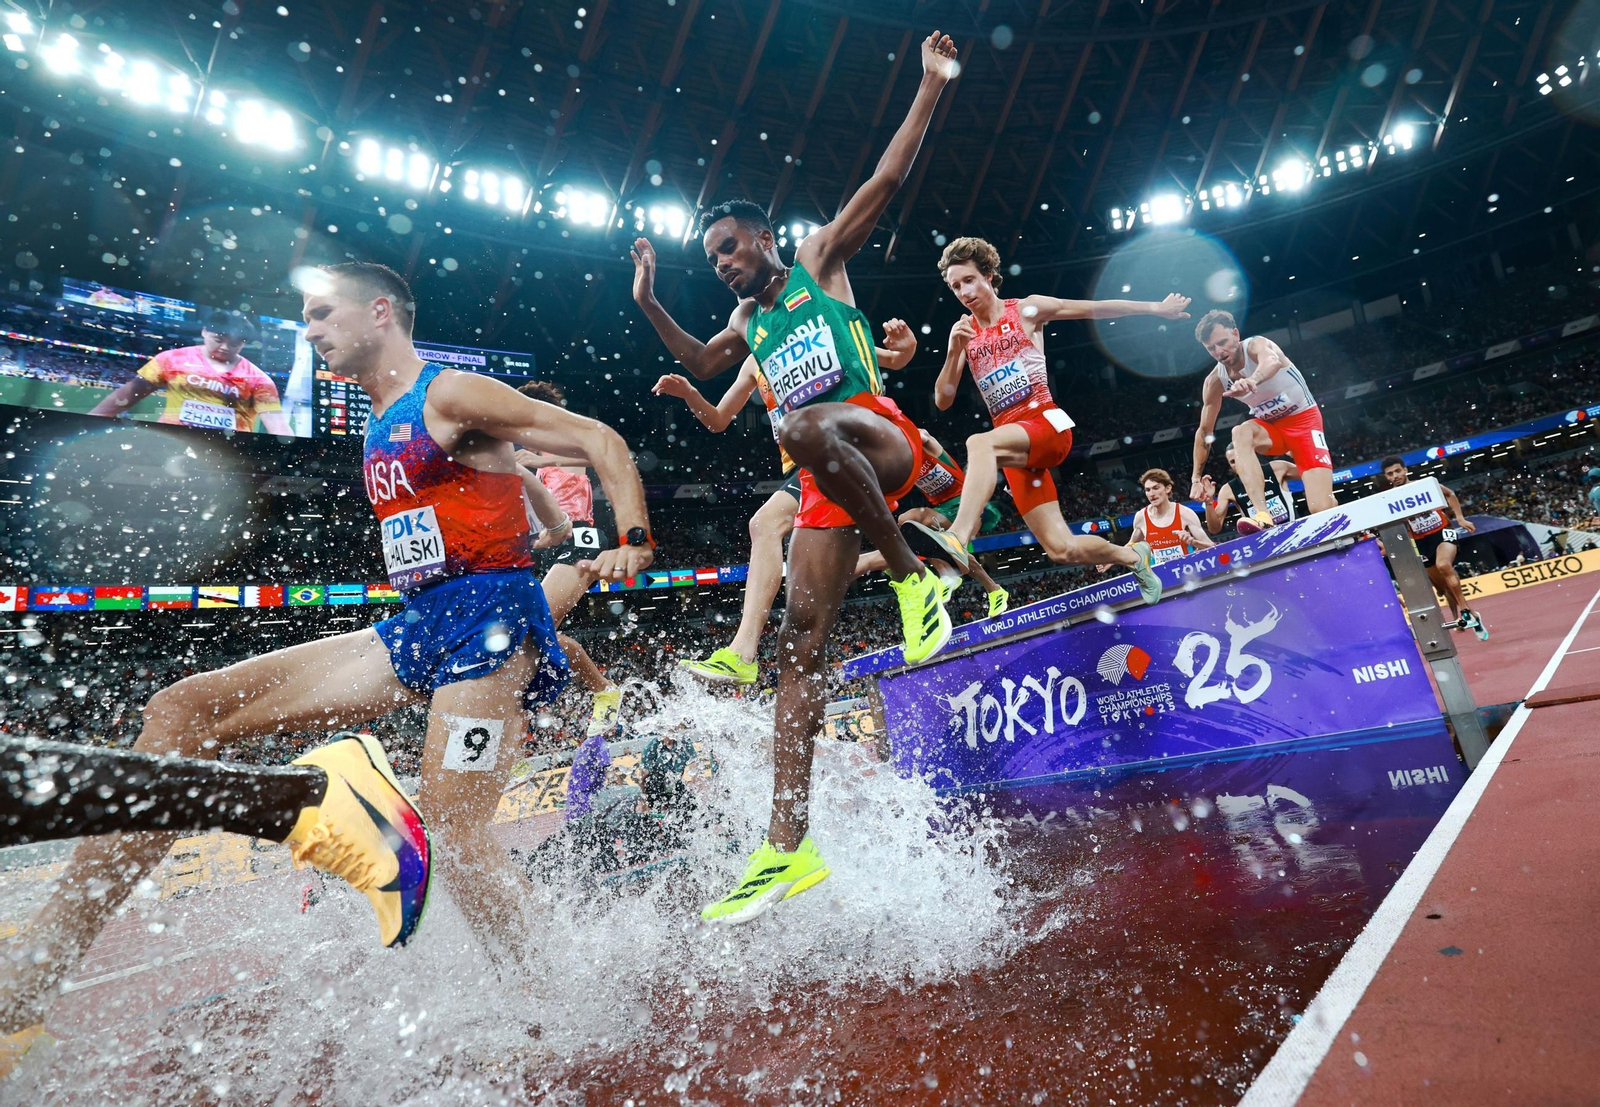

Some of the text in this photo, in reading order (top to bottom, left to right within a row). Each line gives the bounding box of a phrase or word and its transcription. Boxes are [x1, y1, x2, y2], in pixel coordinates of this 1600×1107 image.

[417, 350, 450, 360] THROW
[457, 355, 483, 364] FINAL
[775, 330, 827, 368] TDK
[969, 335, 1020, 361] CANADA
[773, 352, 833, 398] FIREWU
[824, 375, 841, 387] 25
[985, 361, 1020, 386] TDK
[186, 374, 240, 398] CHINA
[986, 375, 1028, 407] DESGAGNÉS
[184, 402, 233, 416] HONDA
[1256, 394, 1286, 413] TDK
[183, 410, 233, 428] ZHANG
[365, 460, 416, 505] USA
[921, 467, 942, 484] TDK
[1388, 491, 1433, 515] NISHI
[1415, 515, 1440, 531] JAZIRI
[1443, 530, 1455, 539] 12
[582, 530, 594, 545] 6
[1159, 547, 1180, 557] TDK
[1233, 545, 1253, 562] 25
[1501, 556, 1583, 589] SEIKO
[982, 581, 1140, 636] WORLD ATHLETICS CHAMPIONSH
[1173, 600, 1283, 709] 25
[1352, 658, 1411, 684] NISHI
[1096, 683, 1171, 705] WORLD ATHLETICS
[1098, 692, 1173, 715] CHAMPIONSHIPS
[938, 666, 1088, 748] TOKYO
[1158, 702, 1176, 713] 25
[462, 727, 491, 763] 9
